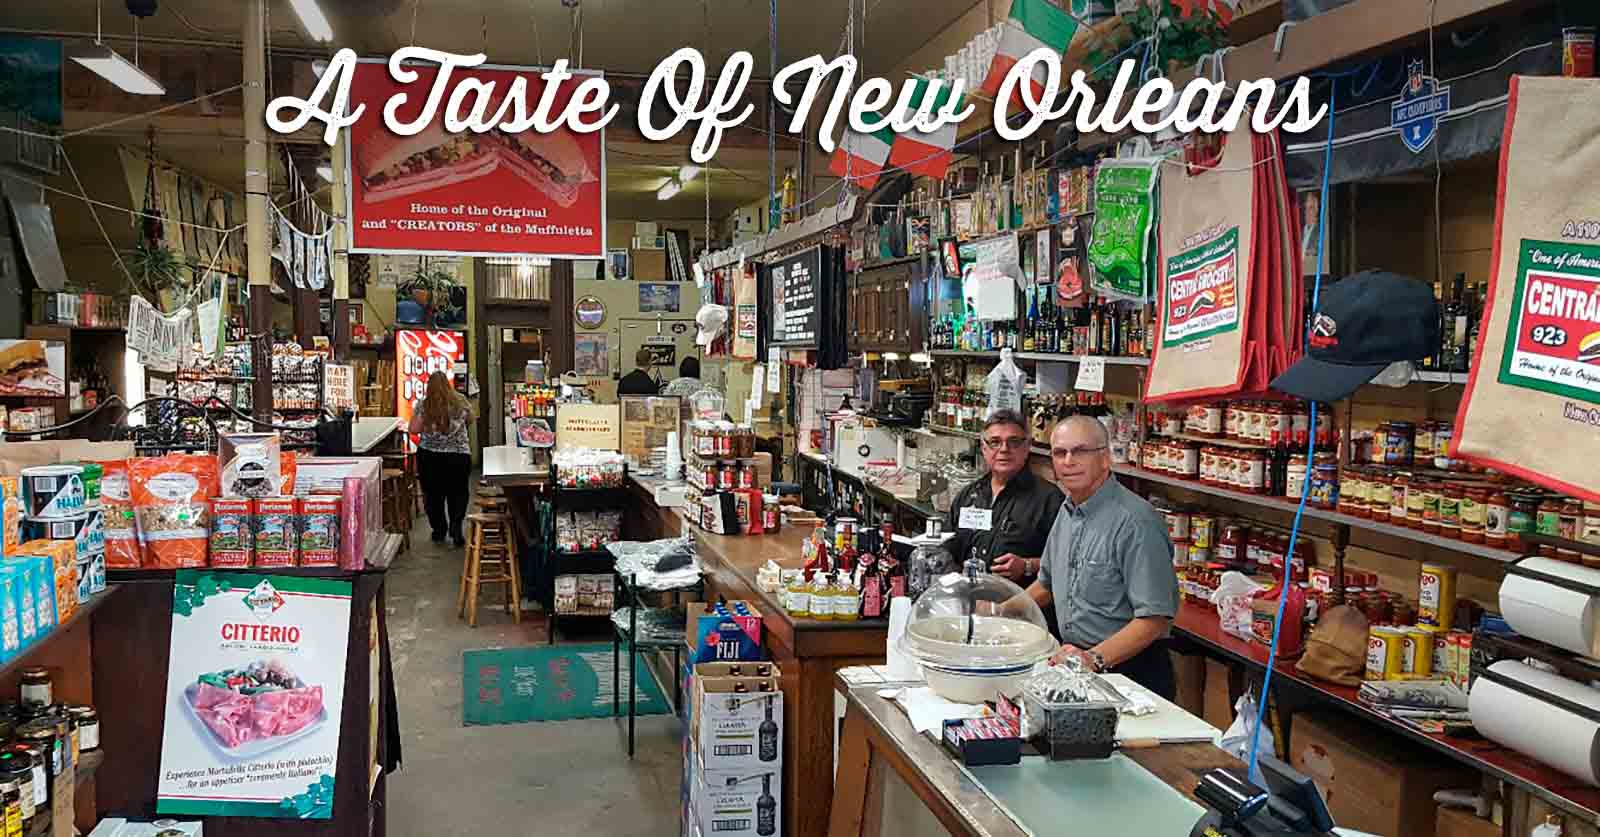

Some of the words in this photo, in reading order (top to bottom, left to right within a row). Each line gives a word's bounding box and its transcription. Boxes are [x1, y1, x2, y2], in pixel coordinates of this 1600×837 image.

[1407, 97, 1443, 118] CHAMPIONS
[410, 203, 448, 214] Home
[451, 204, 465, 215] of
[468, 205, 489, 216] the
[492, 206, 547, 219] Original
[362, 219, 387, 229] and
[485, 223, 498, 233] of
[500, 224, 521, 234] the
[525, 224, 593, 236] Muffuletta
[1528, 279, 1600, 323] CENTRA
[1533, 327, 1565, 346] 923
[221, 623, 301, 643] CITTERIO
[716, 640, 740, 659] FIJI
